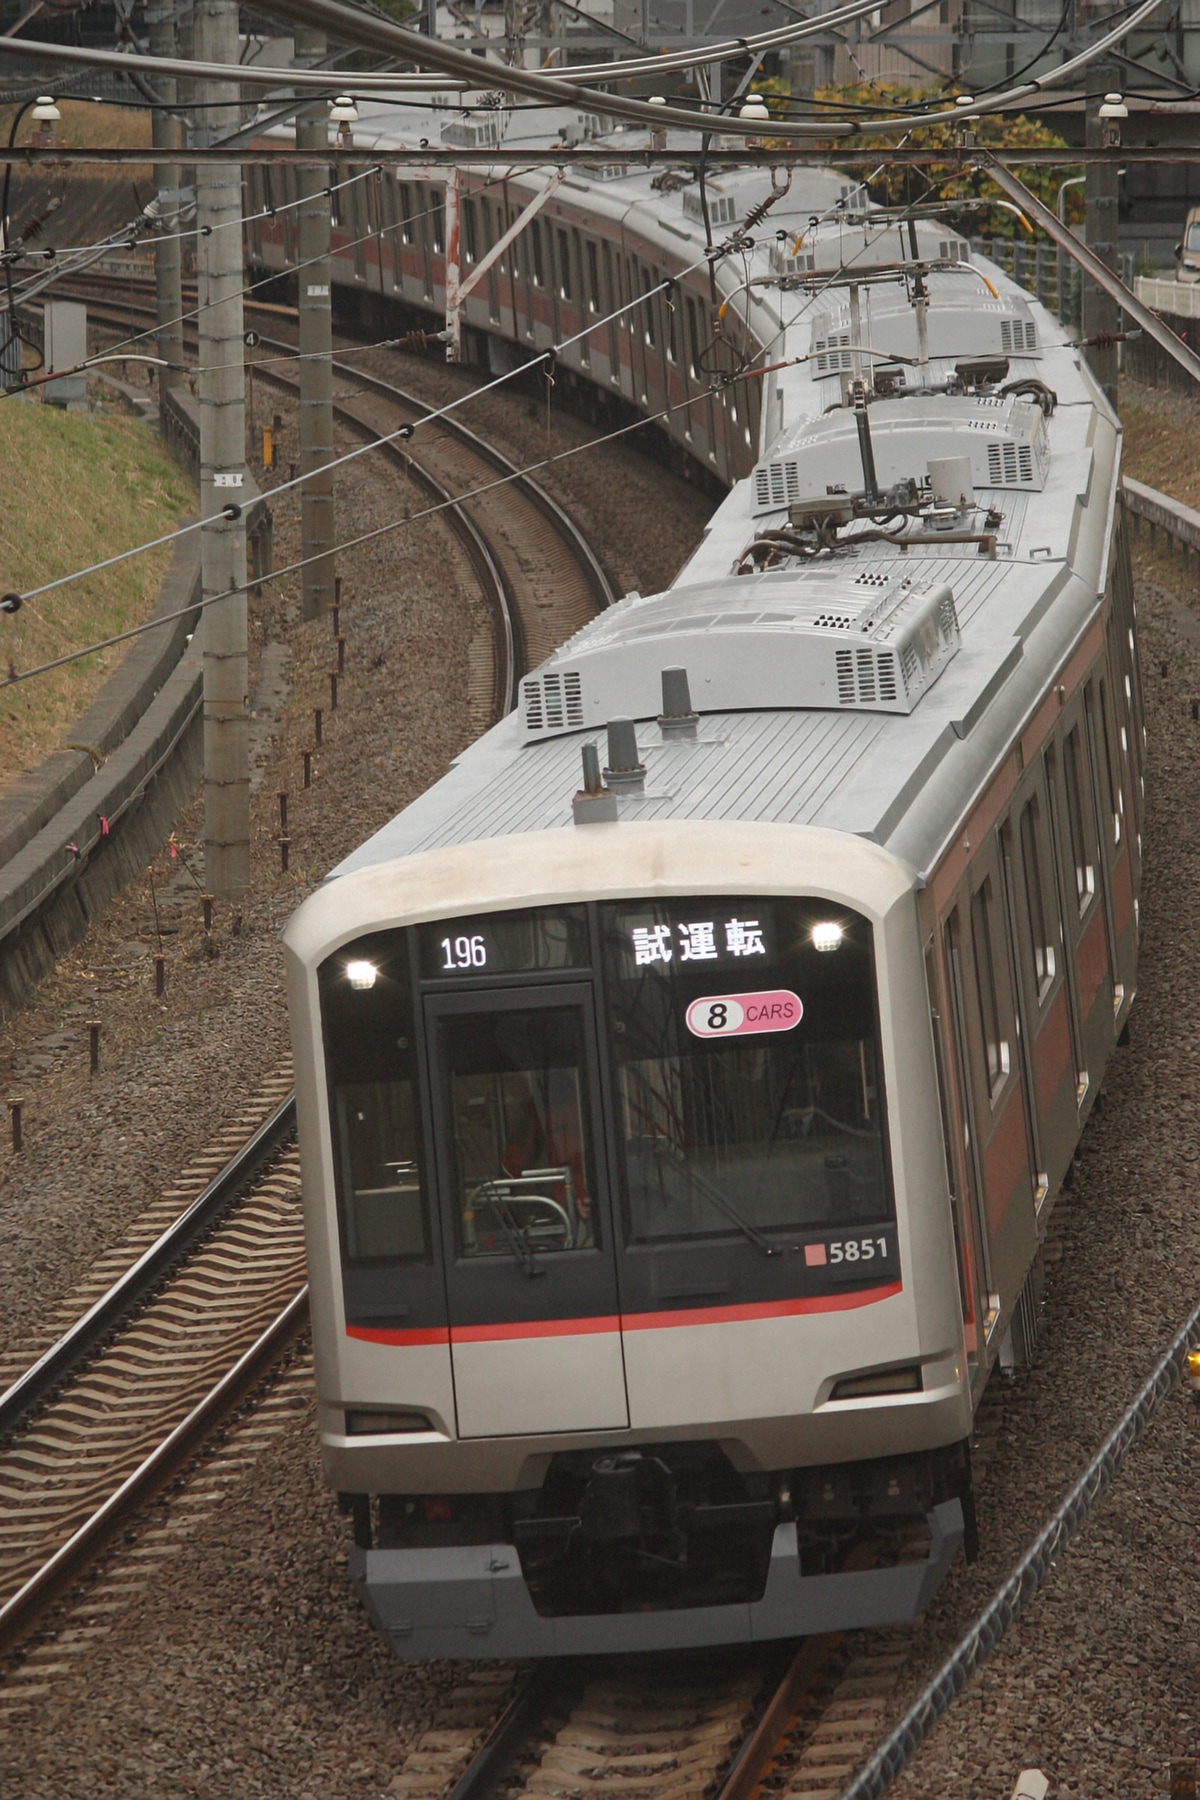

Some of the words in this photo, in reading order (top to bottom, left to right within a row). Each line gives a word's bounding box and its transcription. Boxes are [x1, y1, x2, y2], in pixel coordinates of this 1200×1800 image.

[246, 332, 254, 346] 4
[441, 935, 486, 968] 196
[632, 918, 766, 965] 試運転
[707, 1003, 728, 1029] 8
[746, 1002, 794, 1022] CARS
[830, 1237, 887, 1263] 5851
